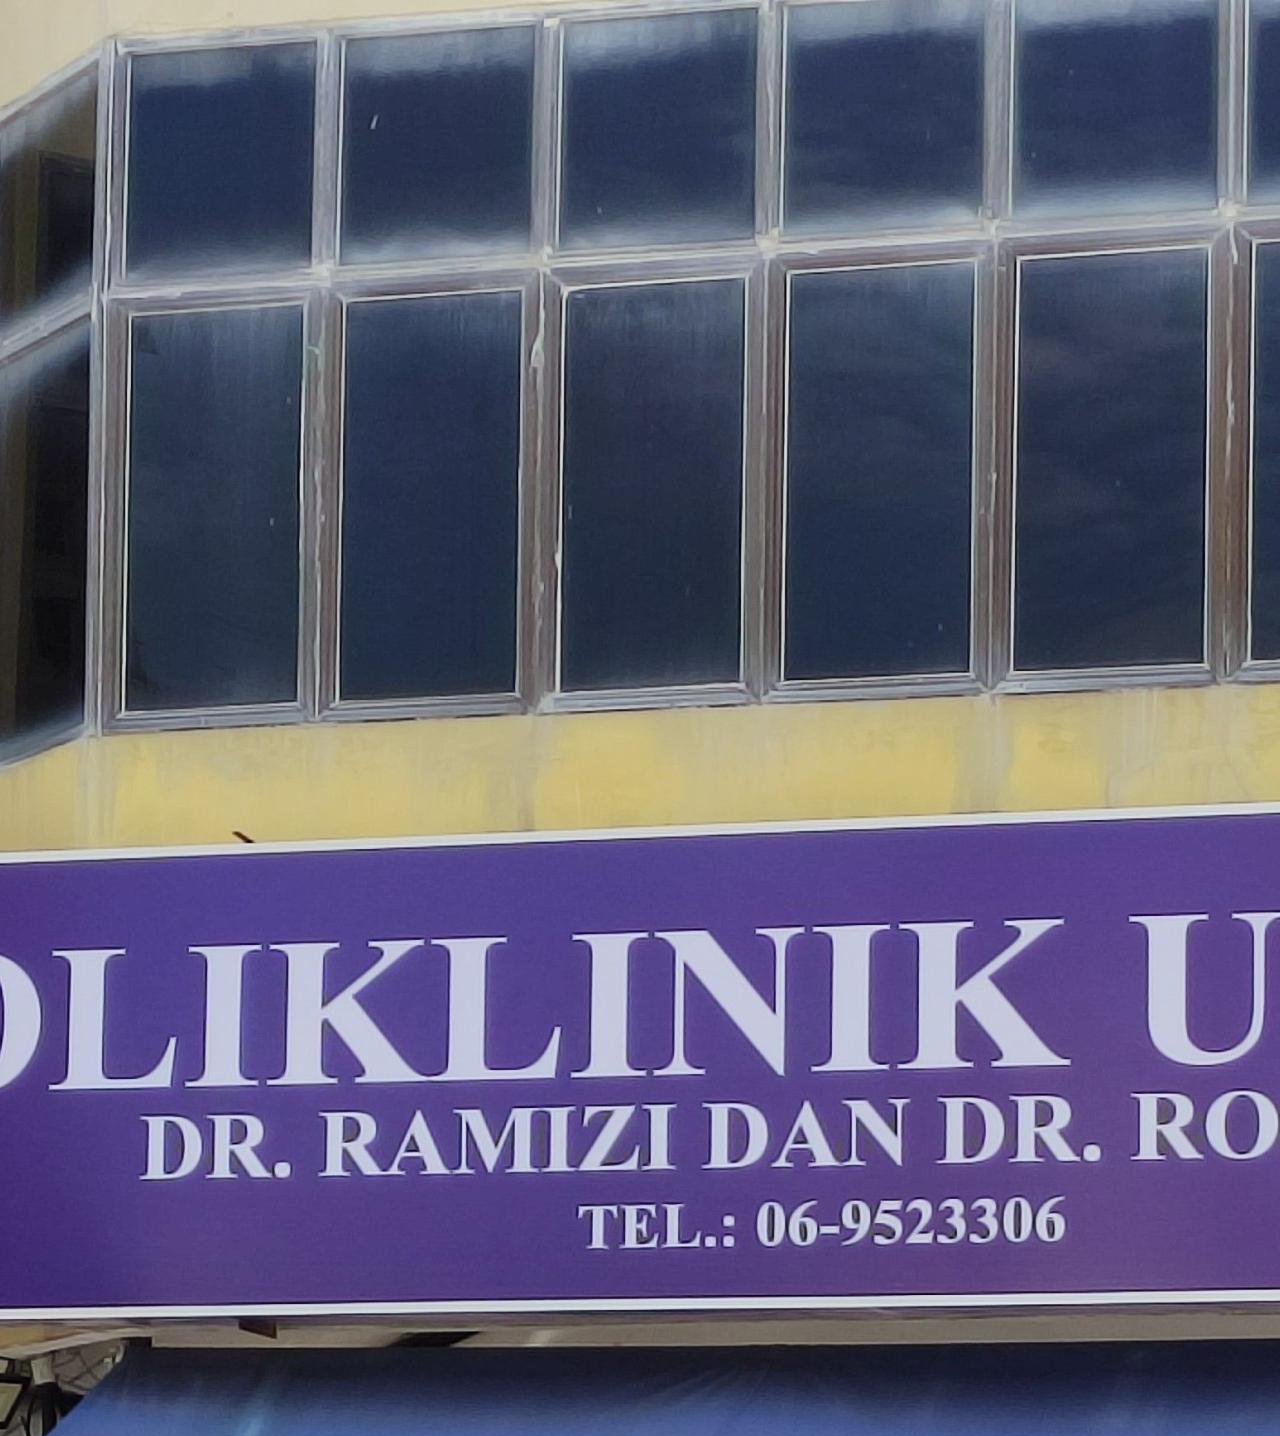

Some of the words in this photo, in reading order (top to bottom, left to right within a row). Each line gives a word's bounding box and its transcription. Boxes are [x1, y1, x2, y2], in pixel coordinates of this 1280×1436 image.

[139, 1112, 291, 1180] DR.
[318, 1103, 677, 1178] RAMIZI
[702, 1098, 909, 1169] DAN
[936, 1094, 1101, 1166] DR.
[578, 1203, 736, 1250] TEL.:
[756, 1194, 1067, 1248] 06-9523306
